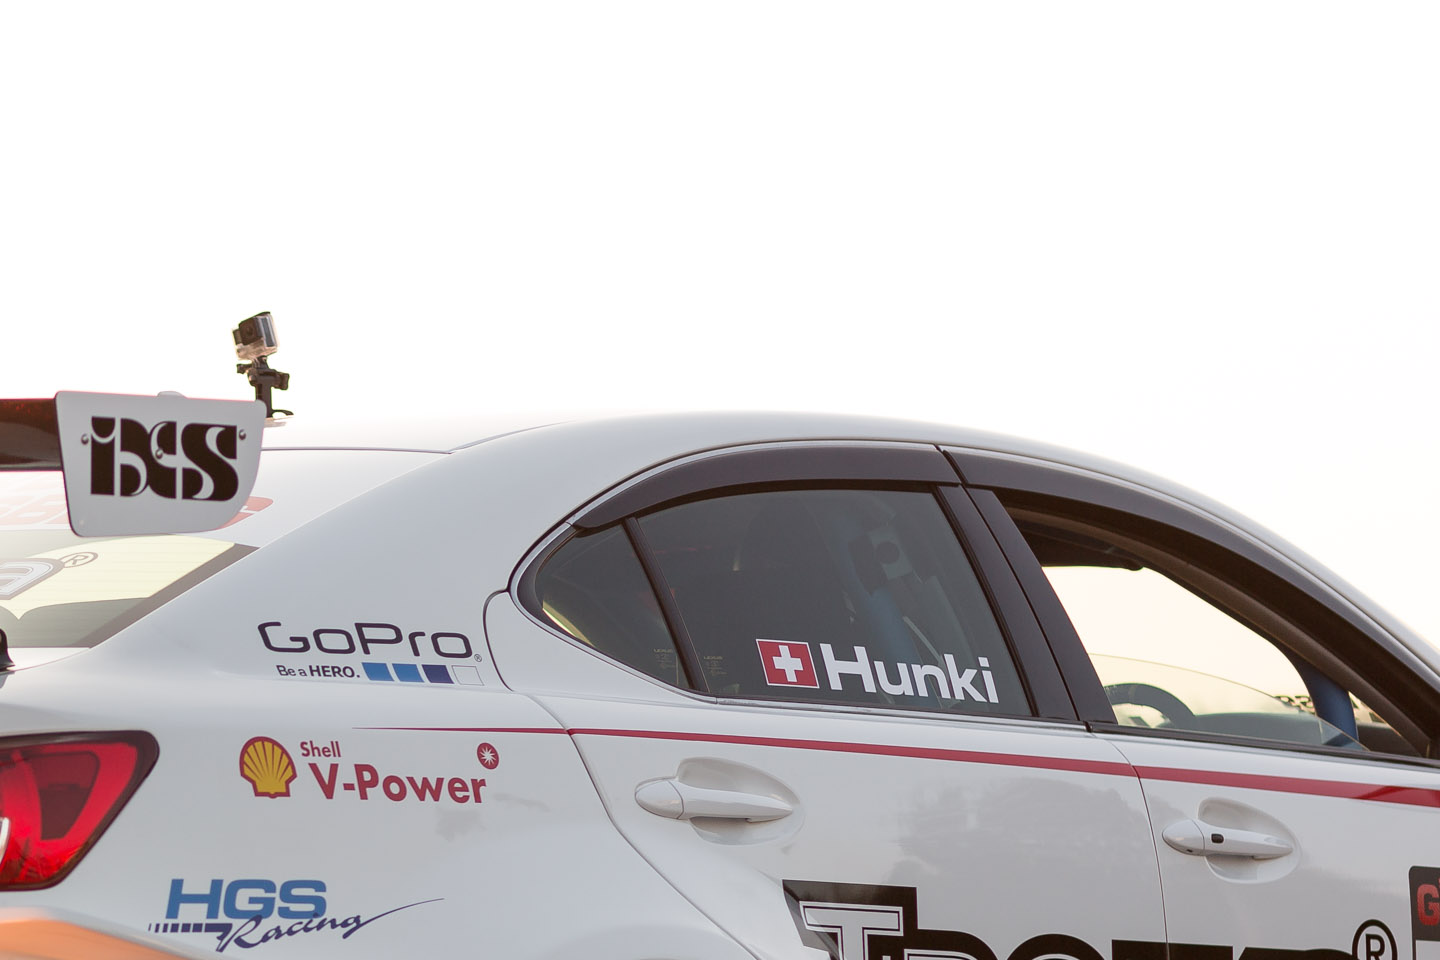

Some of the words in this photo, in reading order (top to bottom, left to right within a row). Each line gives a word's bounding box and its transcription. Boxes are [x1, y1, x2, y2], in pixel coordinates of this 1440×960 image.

[276, 665, 296, 677] Be
[298, 667, 307, 677] a
[309, 665, 360, 678] HERO.
[819, 643, 999, 703] Hunki
[300, 741, 341, 758] Shell
[308, 763, 486, 804] V-Power
[165, 879, 327, 919] HGS
[215, 912, 364, 952] Racing
